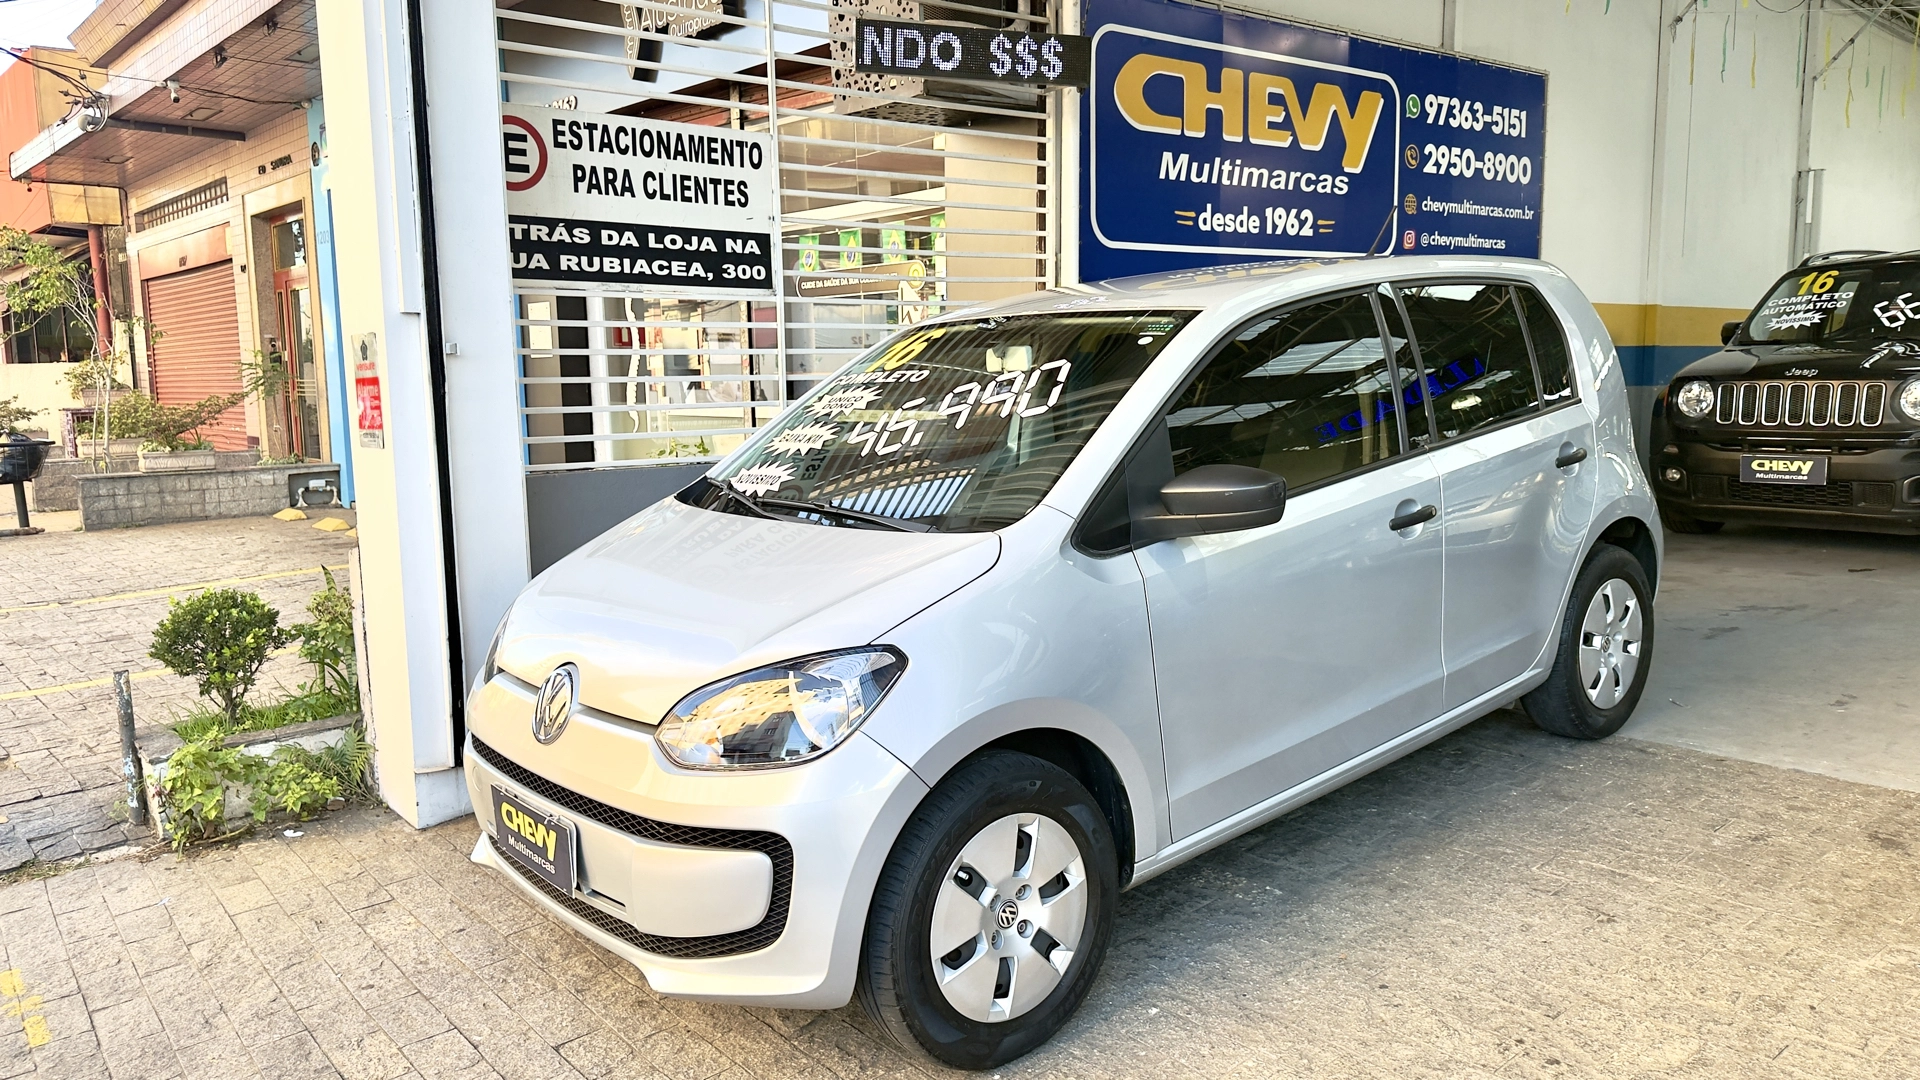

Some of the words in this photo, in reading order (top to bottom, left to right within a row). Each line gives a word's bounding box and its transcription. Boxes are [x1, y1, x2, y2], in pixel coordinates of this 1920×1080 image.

[863, 25, 962, 71] NDO
[989, 33, 1064, 81] $$$
[1113, 53, 1385, 174] CHEVY
[1424, 93, 1528, 139] 97363-5151
[552, 118, 763, 170] ESTACIONAMENTO
[1158, 151, 1350, 196] Multimarcas
[1423, 143, 1532, 185] 2950-8900
[572, 164, 636, 198] PARA
[642, 171, 749, 208] CLIENTES
[1198, 203, 1261, 234] desde
[1265, 207, 1314, 237] 1962
[1421, 196, 1534, 220] chevymultimarcas.com.br
[601, 229, 640, 247] DA
[648, 233, 718, 253] LOJA
[725, 239, 761, 255] NA
[1420, 231, 1506, 250] @chevymultimarcas
[560, 254, 714, 281] RUBIACEA,
[721, 264, 766, 280] 300
[1797, 270, 1840, 296] 16
[1760, 300, 1847, 316] AUTOMÁTICO
[1768, 291, 1855, 307] COMPLETO
[832, 369, 931, 386] COMPLETO
[1784, 367, 1819, 377] Jeep
[1751, 459, 1814, 474] CHEVY
[1755, 472, 1808, 480] Multimarcas
[501, 801, 557, 862] CHEVY
[508, 833, 556, 875] Multimarcas
